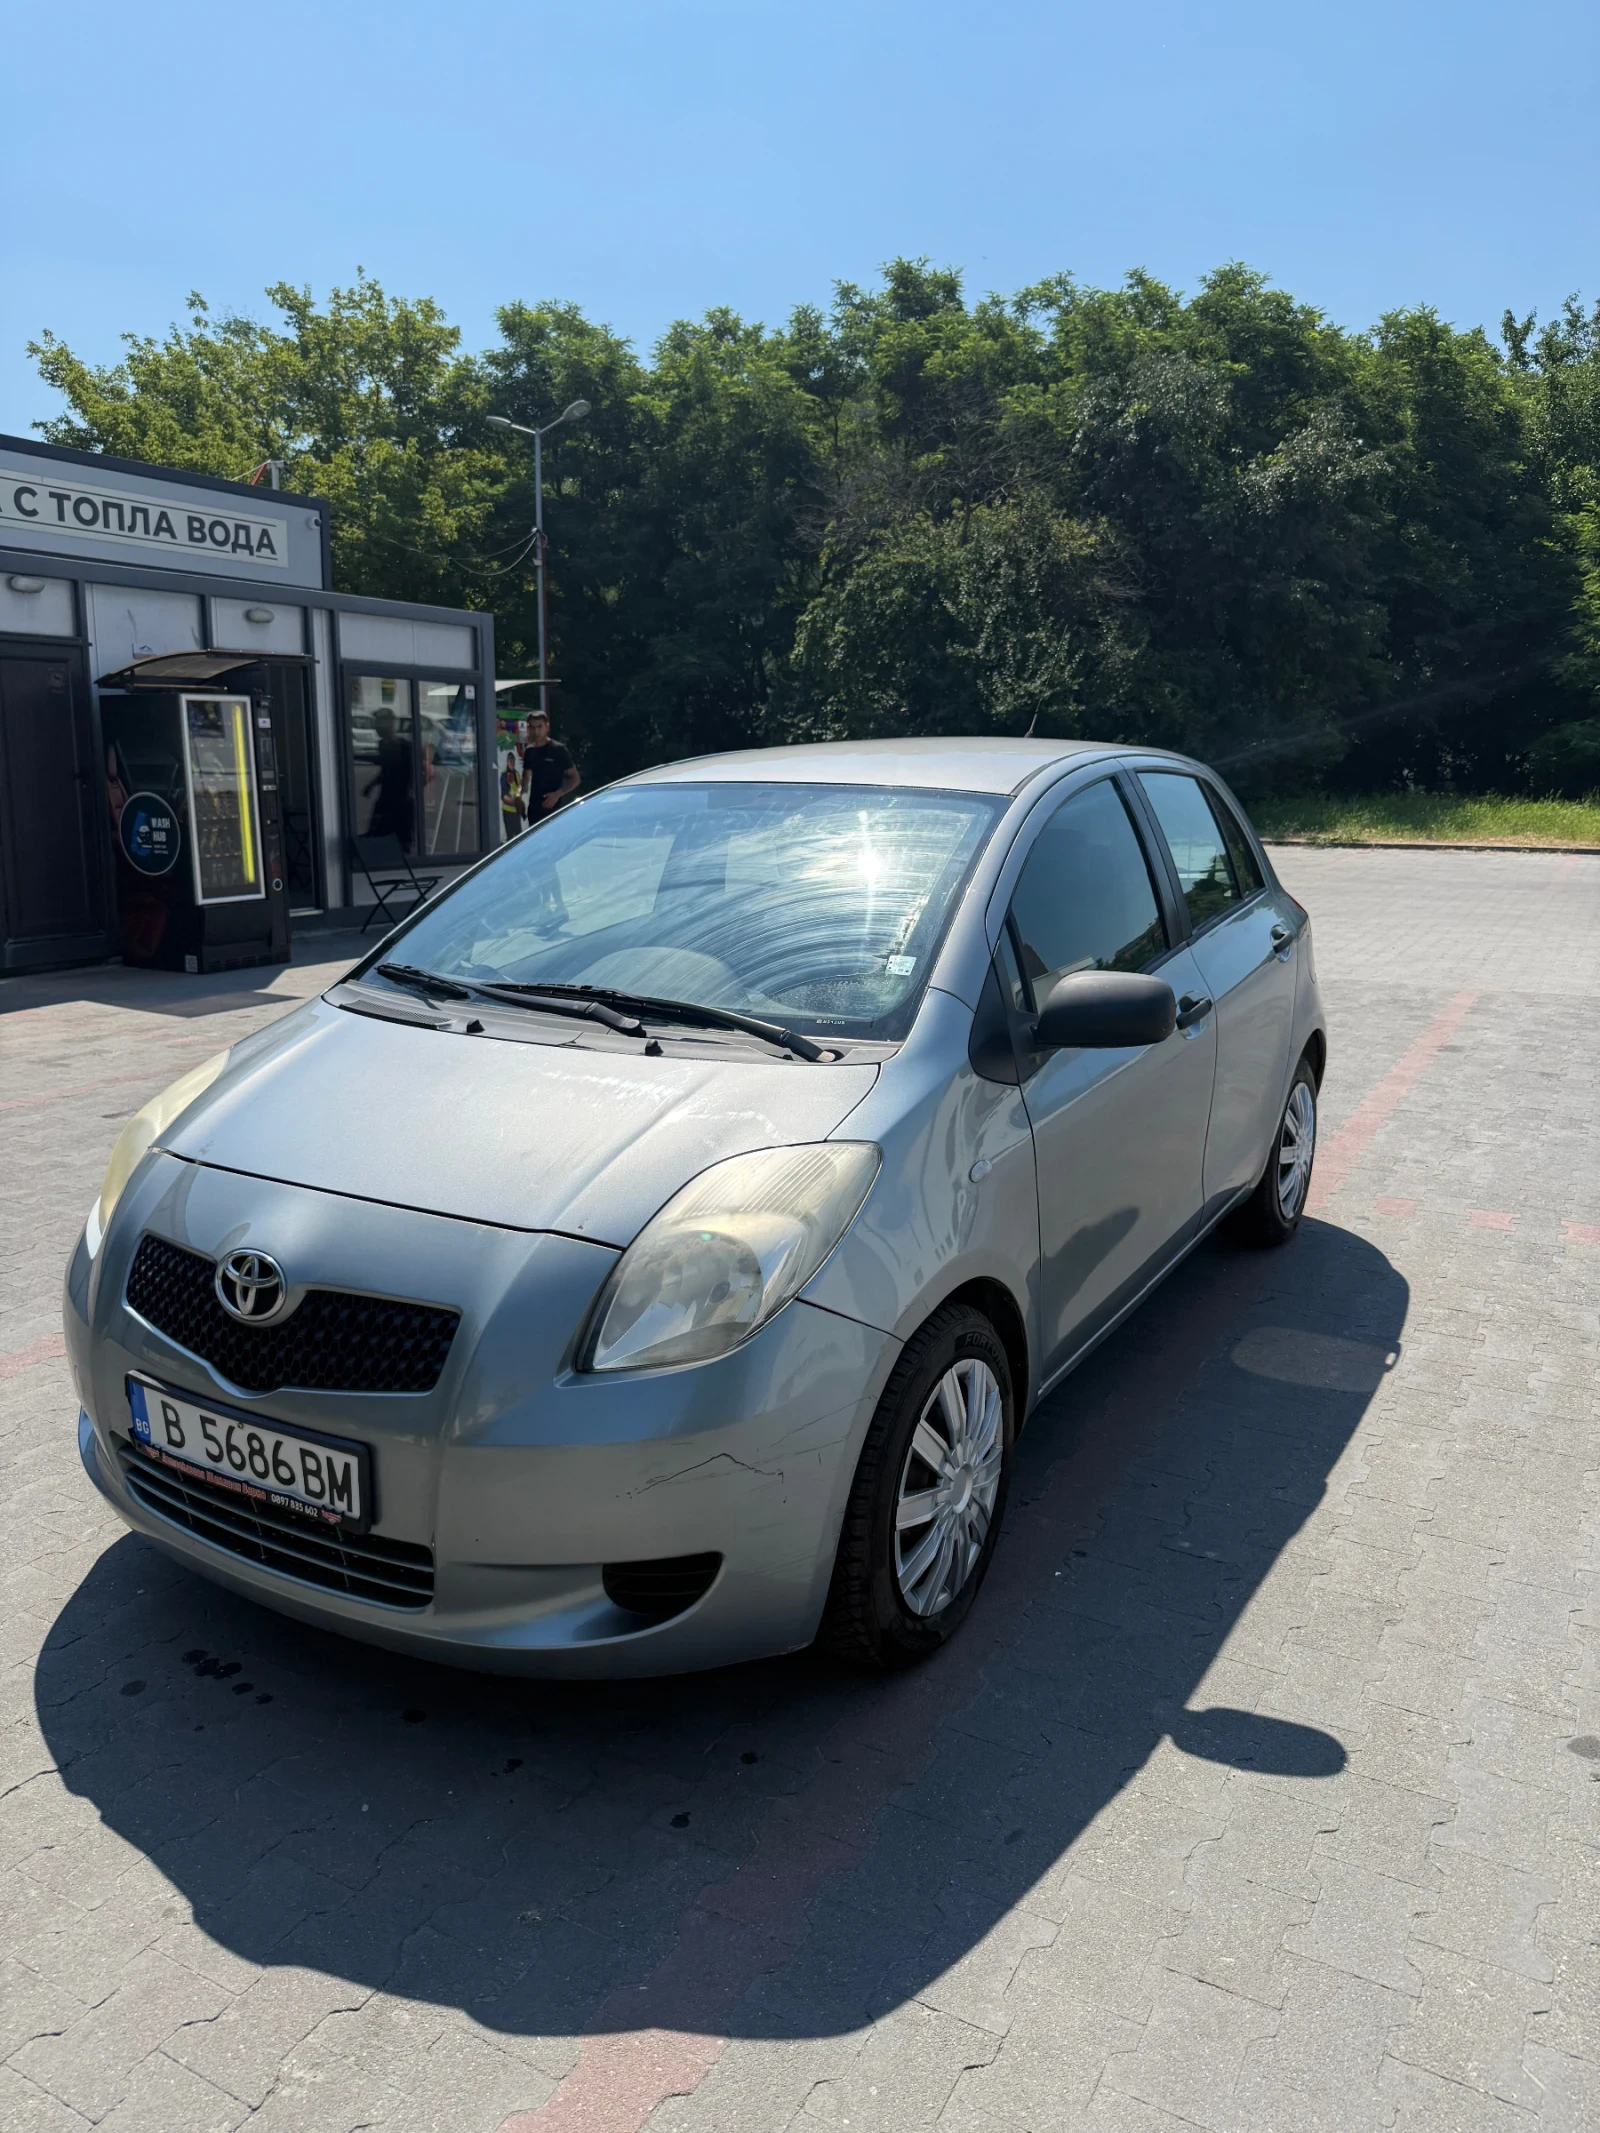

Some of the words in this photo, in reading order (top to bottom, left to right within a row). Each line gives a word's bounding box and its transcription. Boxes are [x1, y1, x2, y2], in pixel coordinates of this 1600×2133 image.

[14, 486, 39, 517] С
[49, 491, 177, 540] ТОПЛА
[187, 516, 277, 556] ВОДА
[151, 817, 170, 829] WASH
[153, 831, 167, 842] HUB
[136, 1418, 149, 1434] BG
[271, 1493, 289, 1506] 0897
[304, 1505, 318, 1517] 602
